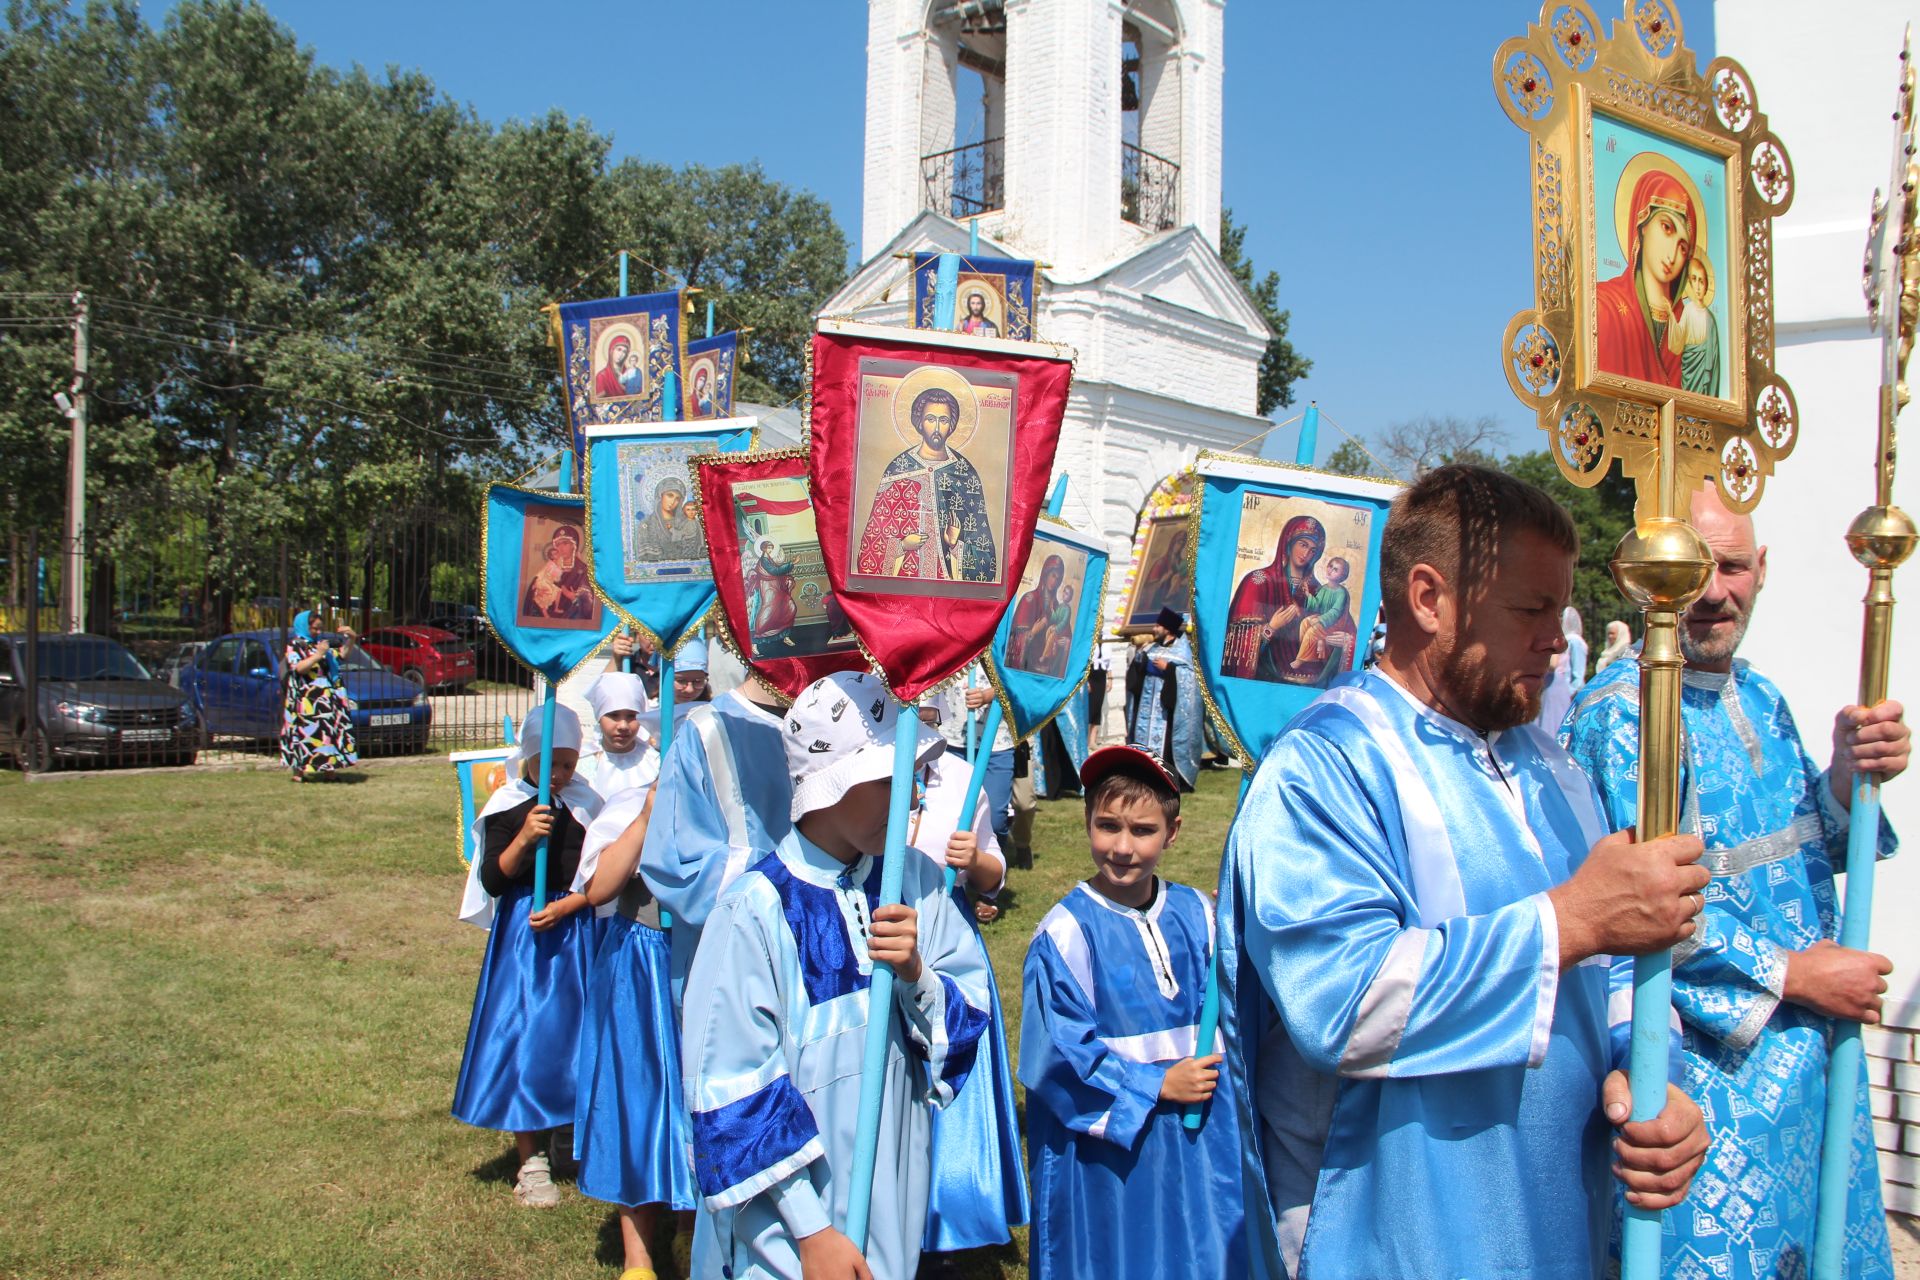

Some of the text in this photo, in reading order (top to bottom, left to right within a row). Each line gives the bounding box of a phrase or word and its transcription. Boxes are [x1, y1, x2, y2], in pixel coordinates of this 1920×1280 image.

[831, 697, 847, 715] NIKE
[870, 698, 883, 716] NIKE
[813, 739, 832, 749] NIKE
